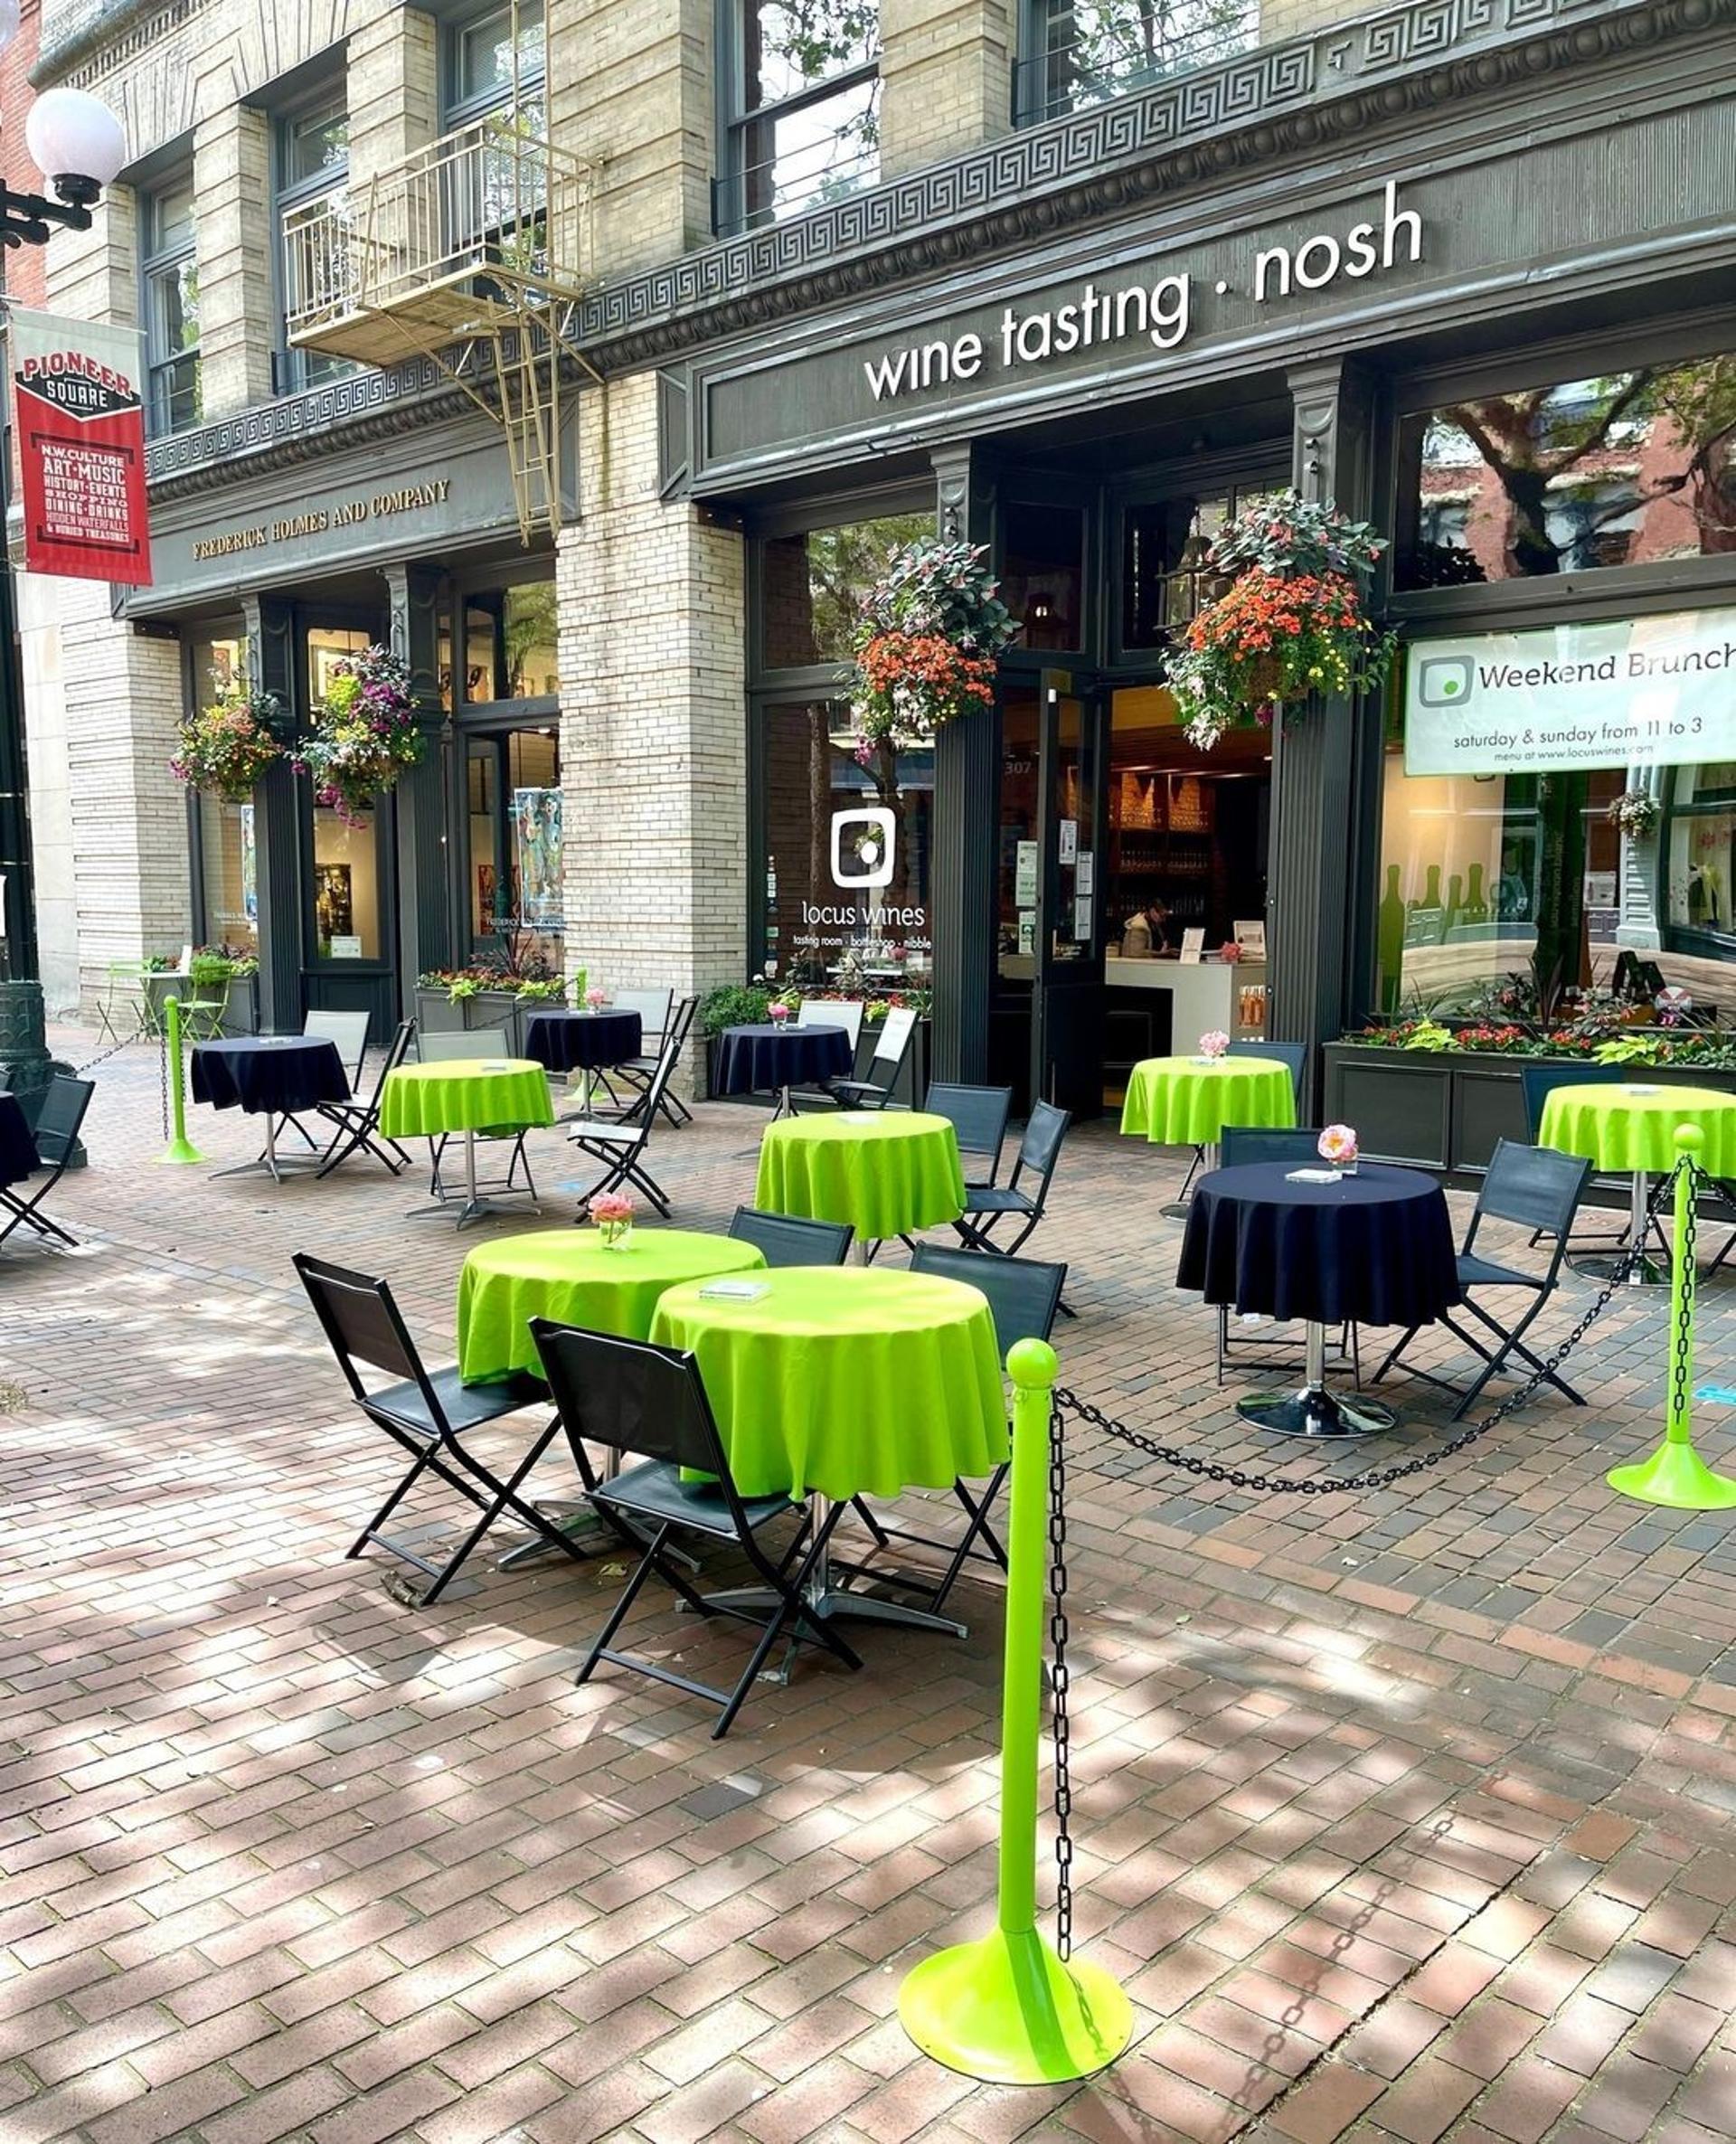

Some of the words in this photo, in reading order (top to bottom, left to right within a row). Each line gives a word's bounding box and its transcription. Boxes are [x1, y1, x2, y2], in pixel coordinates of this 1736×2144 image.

[863, 332, 982, 401] wine
[1000, 272, 1190, 366] tasting
[1254, 181, 1422, 301] nosh
[23, 352, 133, 401] PIONEER
[46, 380, 108, 408] SQUARE
[44, 489, 127, 507] SHOPPING
[193, 526, 268, 561] FREDERICK
[271, 511, 329, 542] HOLMES
[333, 501, 367, 527] AND
[370, 480, 450, 516] COMPANY
[1478, 656, 1617, 689] Weekend
[1454, 731, 1517, 749] saturday
[1523, 729, 1534, 744] &
[1540, 726, 1597, 744] sunday
[1602, 723, 1637, 740] from
[1647, 721, 1660, 736] 11
[1669, 721, 1684, 735] to
[1691, 717, 1703, 733] 3
[1495, 752, 1522, 762] menu
[1524, 751, 1535, 760] at
[1538, 744, 1654, 760] www.locuswines.com
[1005, 761, 1032, 774] 307
[802, 901, 856, 925] locus
[861, 906, 926, 926] wines
[793, 935, 819, 949] tasting
[821, 937, 843, 946] room
[904, 935, 931, 949] nibble
